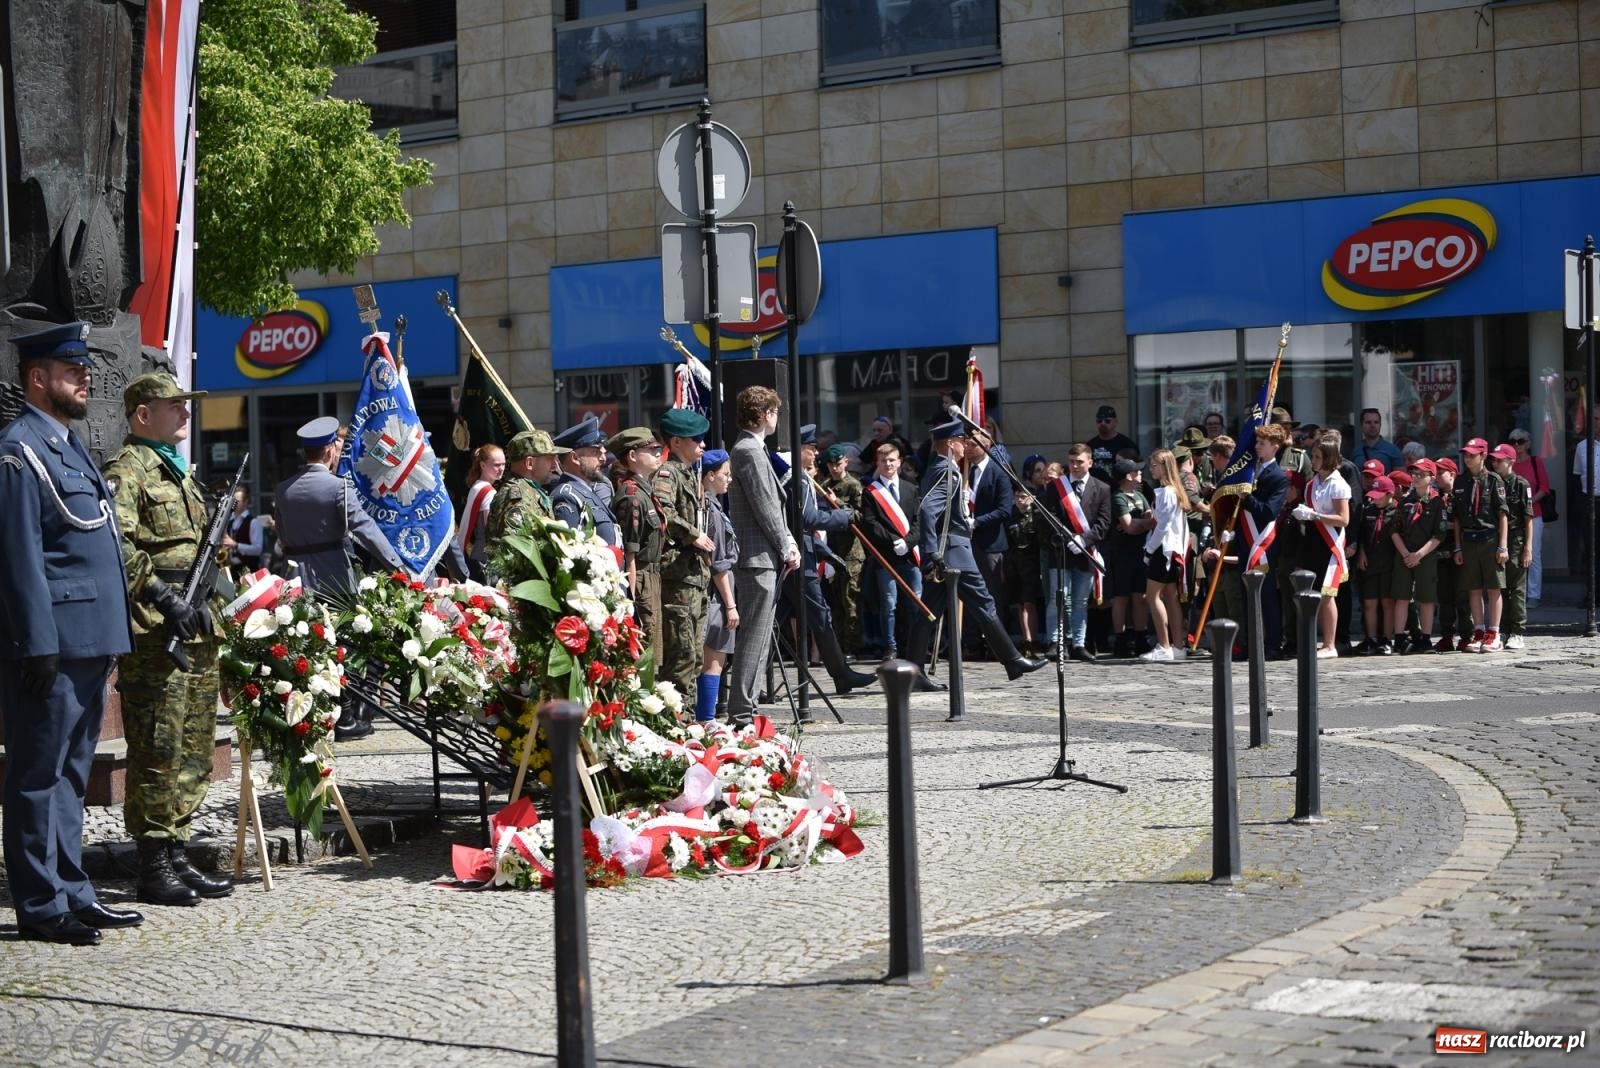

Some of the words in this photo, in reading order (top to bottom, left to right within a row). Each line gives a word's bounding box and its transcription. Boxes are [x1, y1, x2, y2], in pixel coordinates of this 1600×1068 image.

[1348, 235, 1466, 274] PEPCO
[247, 325, 311, 353] PEPCO
[1417, 364, 1452, 382] HIT!
[1416, 383, 1452, 392] CENOWY
[1223, 451, 1253, 479] ORZU
